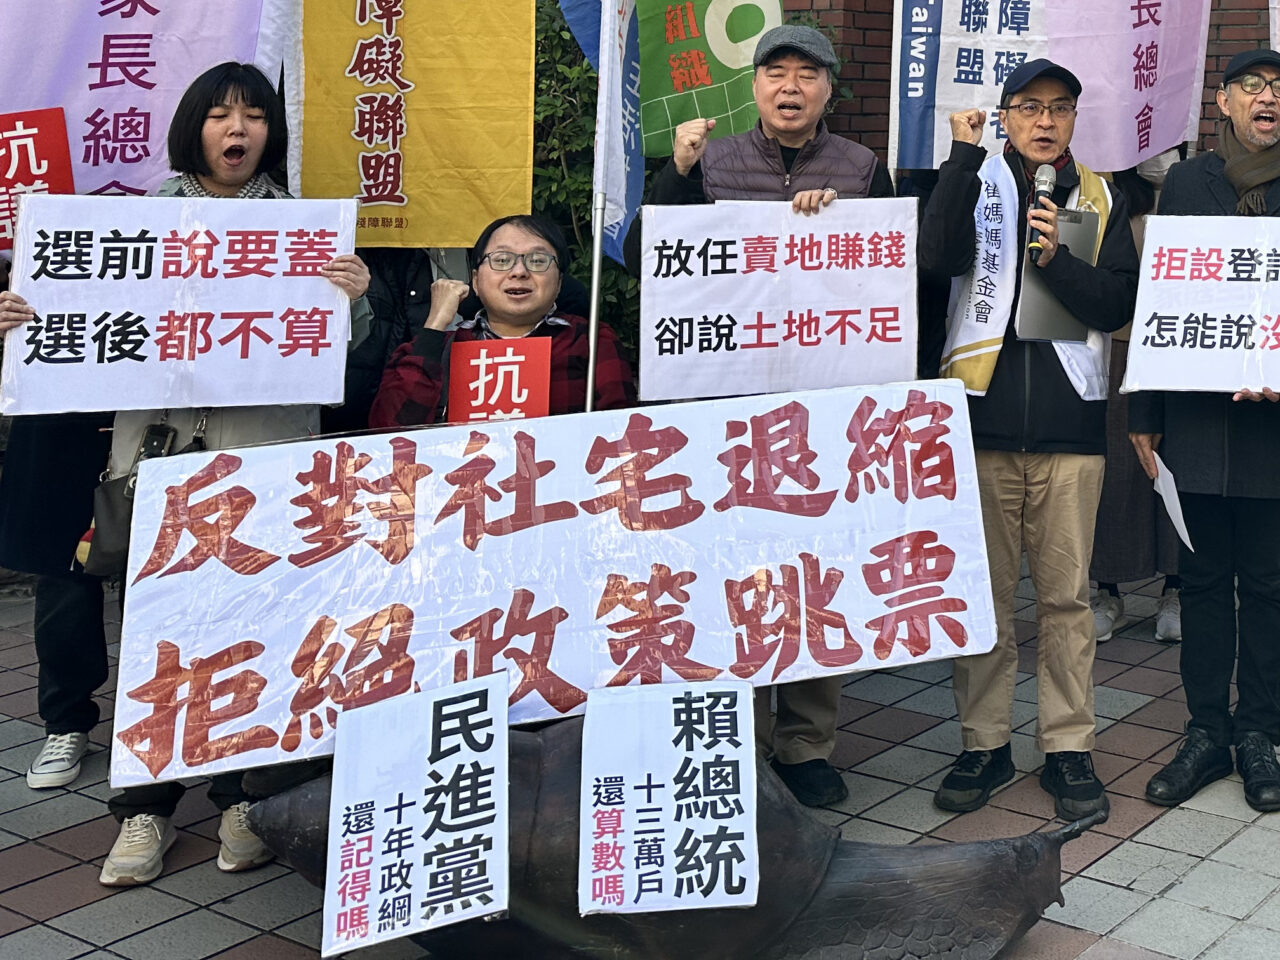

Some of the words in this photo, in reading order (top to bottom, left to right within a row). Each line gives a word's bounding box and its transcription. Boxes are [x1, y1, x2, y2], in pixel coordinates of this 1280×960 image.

[31, 227, 340, 285] 選前說要蓋
[653, 231, 907, 281] 放任賣地賺錢
[973, 180, 1004, 324] 崔媽媽基金會
[22, 309, 333, 367] 選後都不算
[468, 347, 529, 424] 抗
[653, 305, 904, 358] 卻說土地不足
[130, 390, 960, 586] 反對社宅退縮
[116, 529, 971, 781] 拒絕政策跳票
[376, 790, 417, 930] 十年政綱
[418, 687, 499, 924] 民進黨
[589, 774, 628, 908] 還算數嗎
[632, 771, 666, 906] 十三萬戶
[671, 689, 748, 902] 賴總統
[335, 800, 377, 945] 還記得嗎
